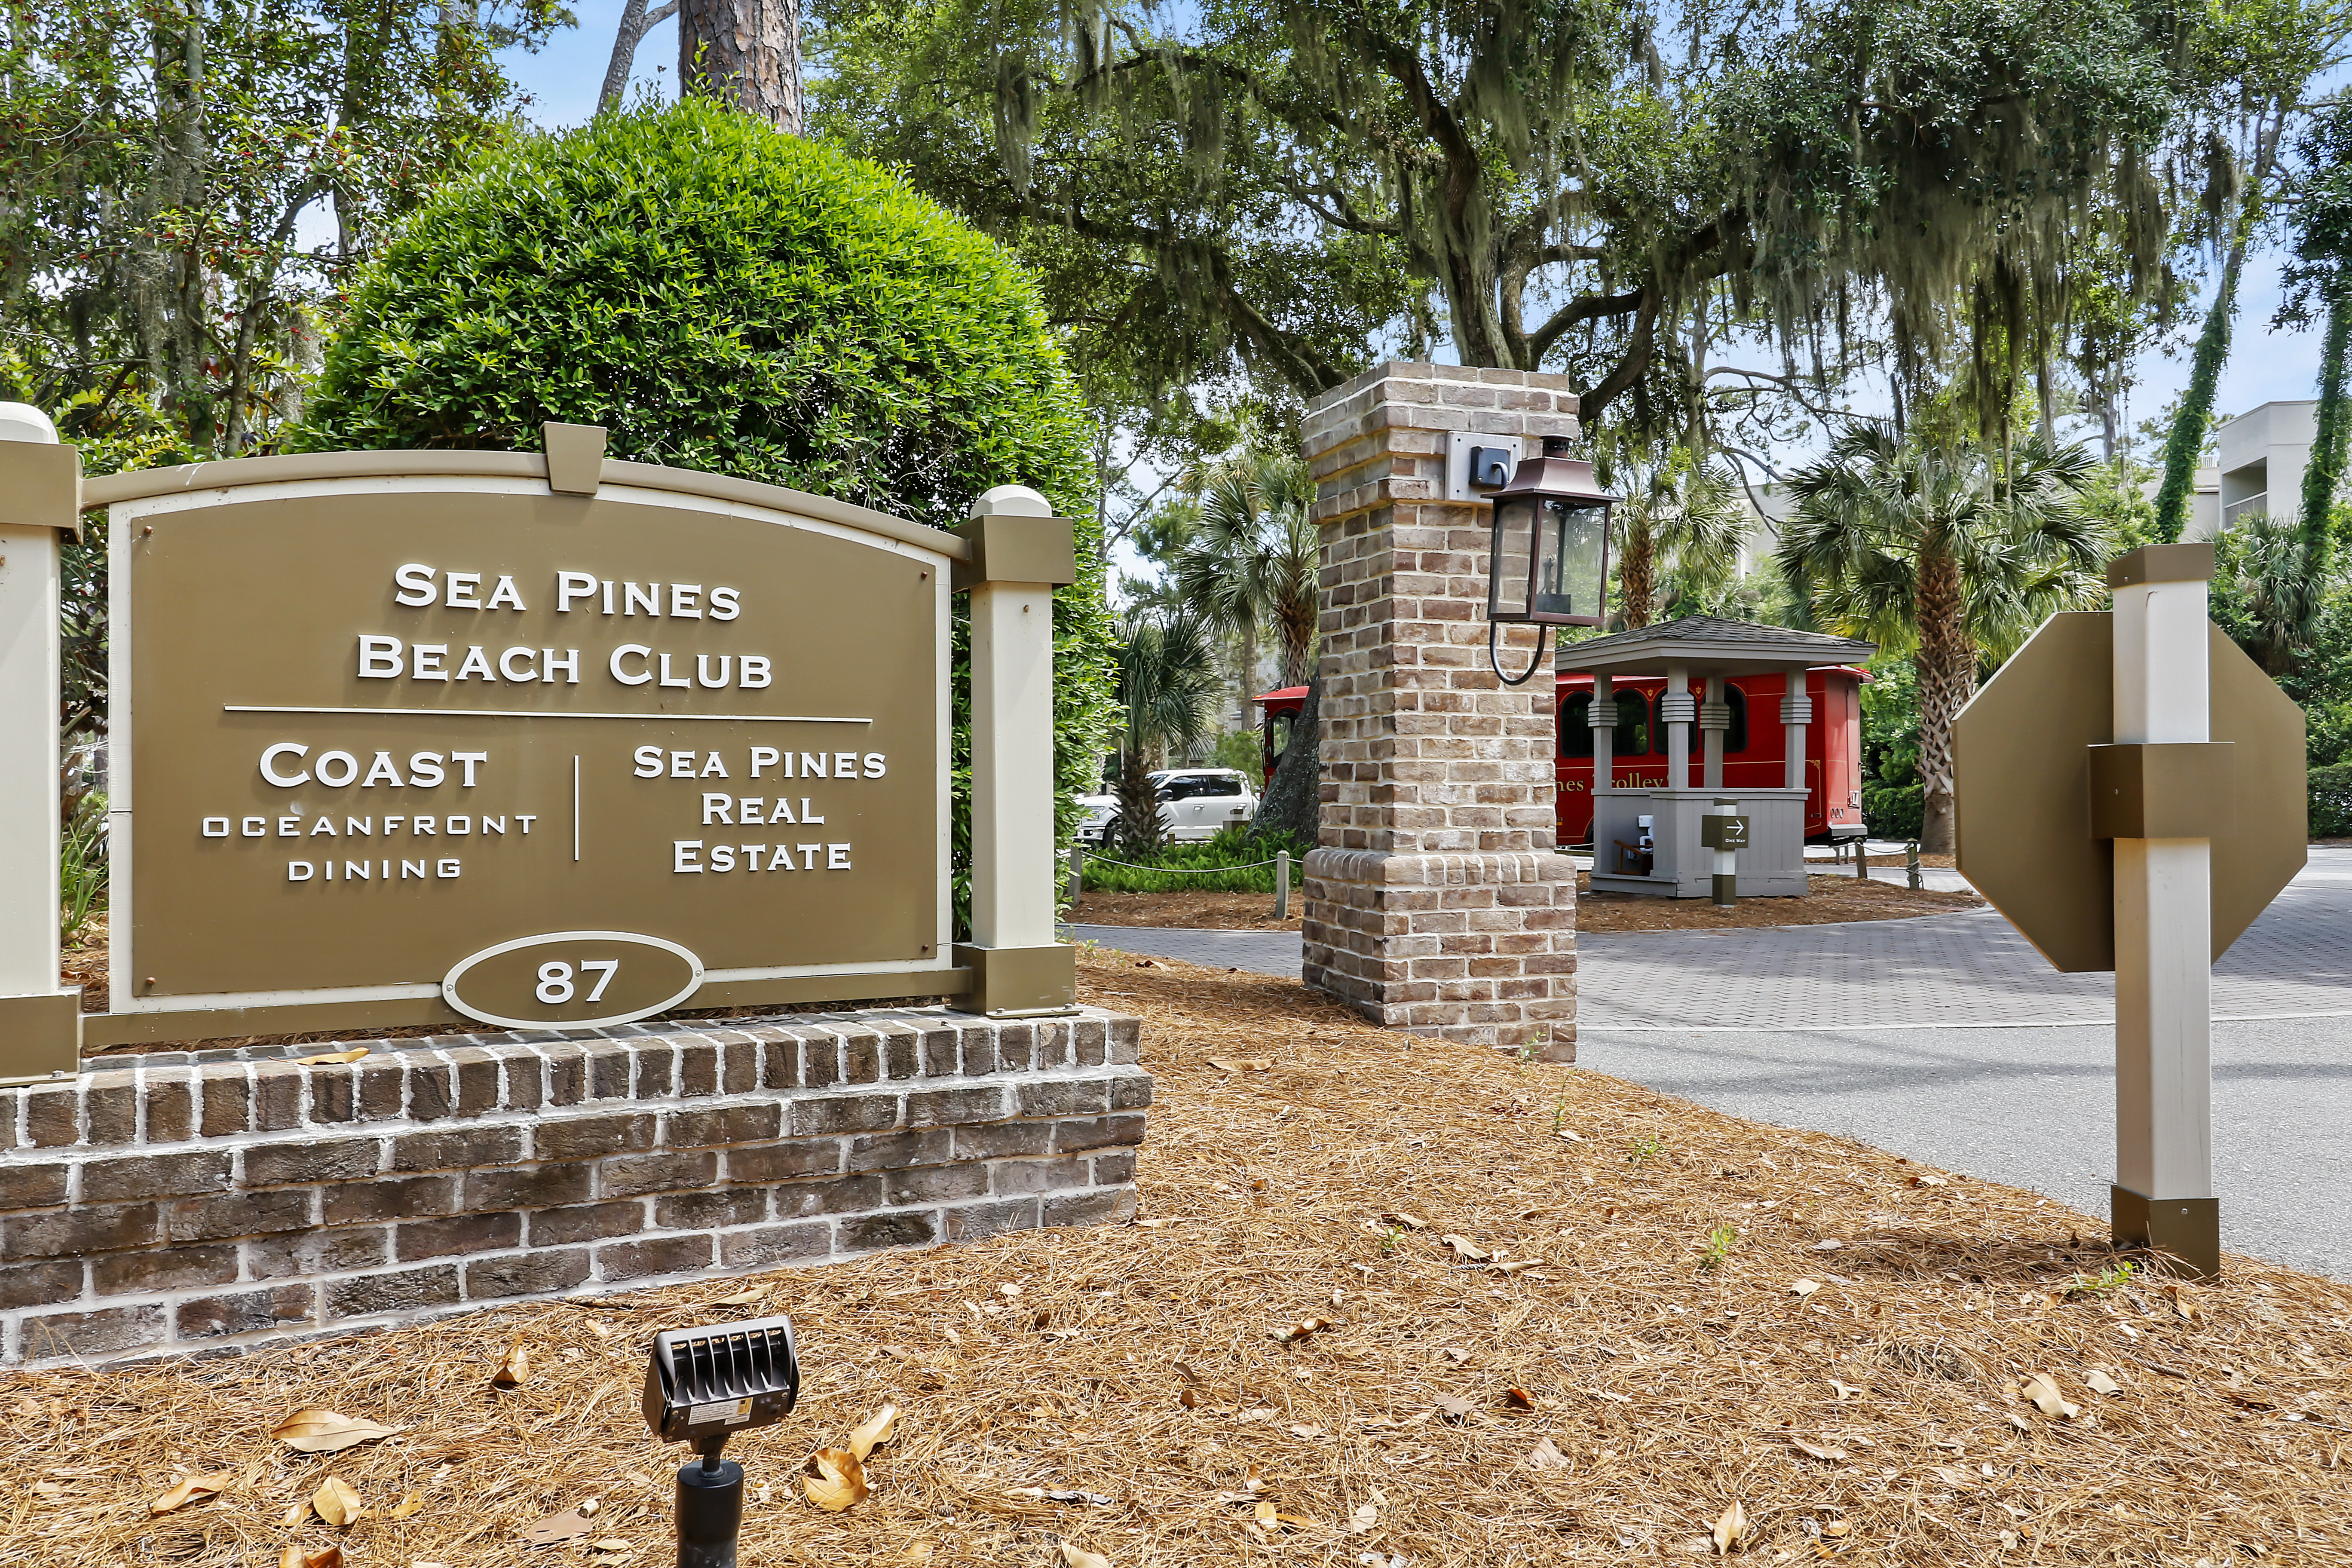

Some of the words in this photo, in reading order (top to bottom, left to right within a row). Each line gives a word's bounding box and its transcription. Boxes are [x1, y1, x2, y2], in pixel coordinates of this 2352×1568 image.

[395, 563, 527, 611] SEA
[557, 571, 741, 621] PINES
[357, 634, 580, 683] BEACH
[609, 644, 772, 689] CLUB
[260, 742, 487, 787] COAST
[634, 745, 729, 778] SEA
[750, 747, 886, 779] PINES
[1556, 780, 1584, 791] nes
[202, 815, 537, 837] OCEANFRONT
[702, 793, 824, 825] REAL
[288, 858, 460, 881] DINING
[674, 839, 851, 873] ESTATE
[536, 959, 619, 1004] 87
